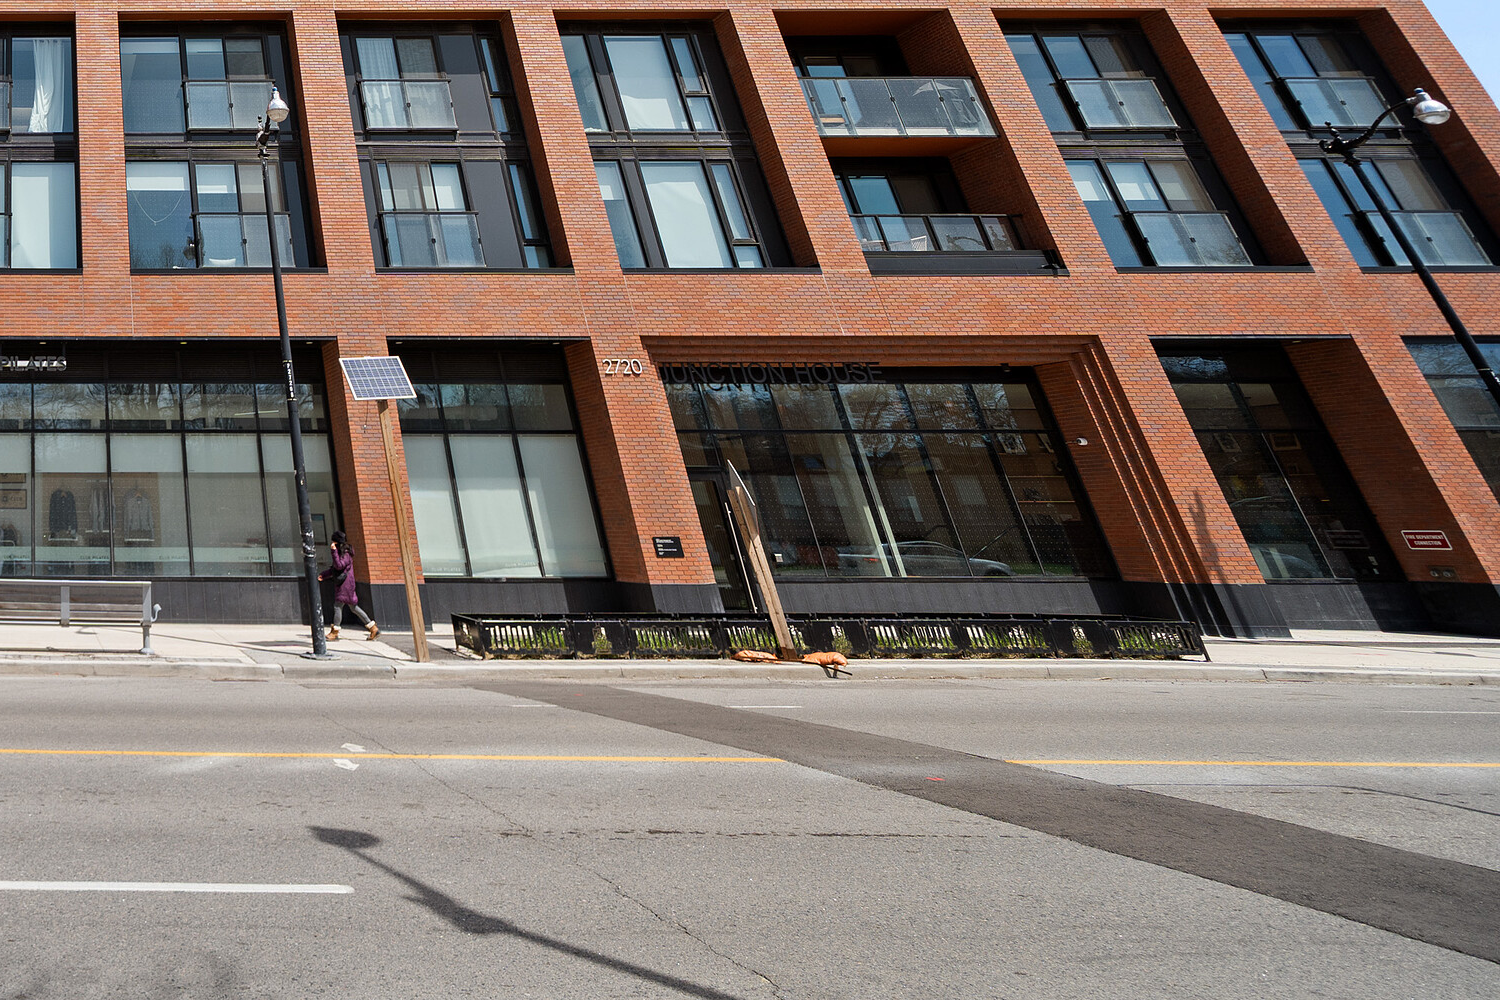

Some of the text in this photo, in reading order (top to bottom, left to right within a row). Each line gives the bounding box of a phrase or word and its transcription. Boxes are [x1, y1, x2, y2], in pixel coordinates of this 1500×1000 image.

[0, 356, 67, 371] PILATES
[602, 359, 643, 375] 2720
[660, 362, 887, 384] JUNCTION HOUSE
